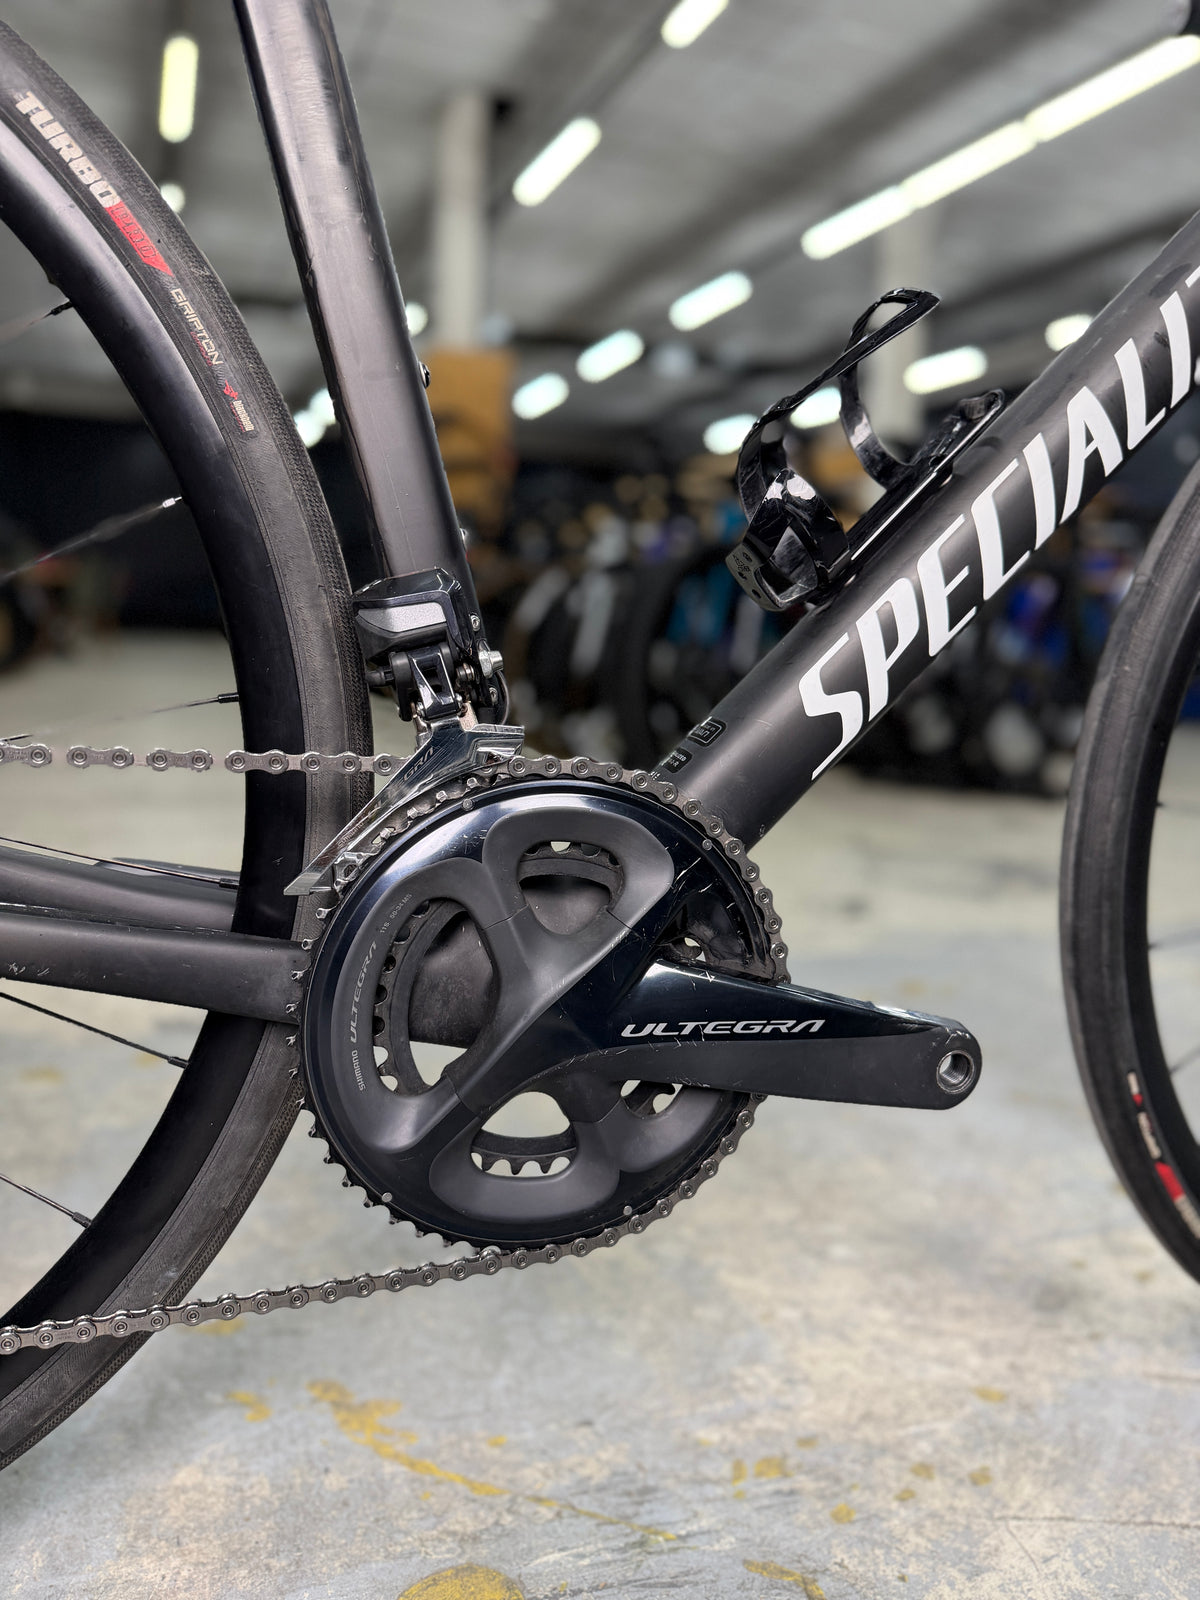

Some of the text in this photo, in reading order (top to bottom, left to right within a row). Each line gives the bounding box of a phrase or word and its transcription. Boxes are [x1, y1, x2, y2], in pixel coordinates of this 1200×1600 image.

[14, 91, 156, 258] TURBO PRO
[170, 288, 224, 365] GRIPTON
[799, 265, 1200, 780] SPECIALI
[350, 941, 377, 1043] ULTEGRA
[620, 1019, 826, 1038] ULTEGRA
[351, 1050, 366, 1091] SHIMANO
